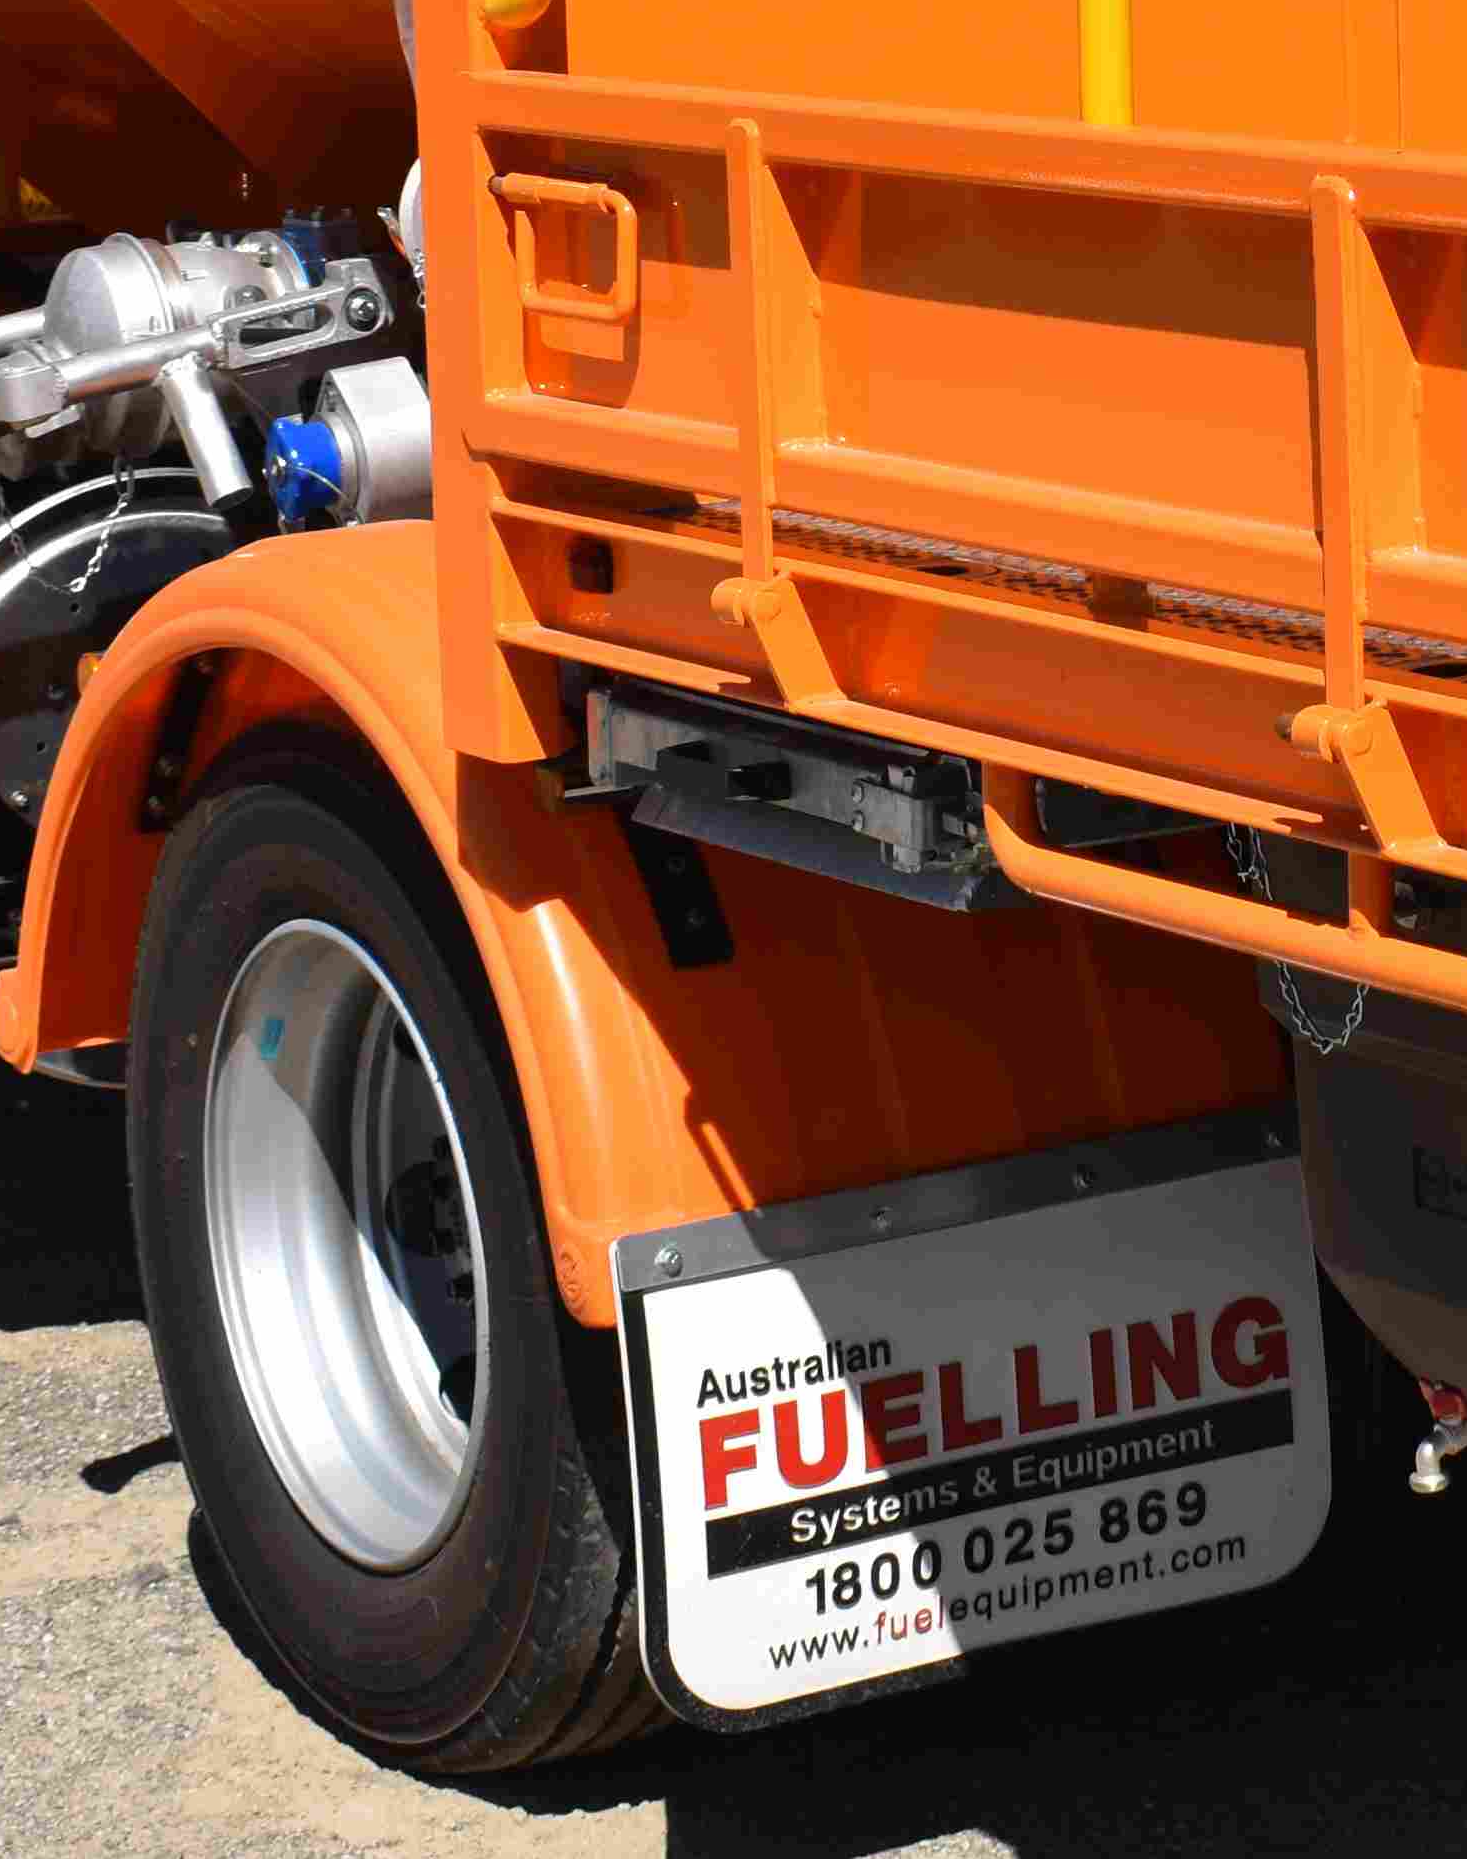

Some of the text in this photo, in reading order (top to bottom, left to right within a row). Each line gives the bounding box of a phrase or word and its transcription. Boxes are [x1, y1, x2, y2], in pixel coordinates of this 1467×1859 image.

[696, 1335, 893, 1409] Australian
[697, 1295, 1291, 1512] FUELLING
[789, 1417, 1217, 1547] Systems & Equipment
[805, 1481, 1210, 1616] 1800 025 869
[768, 1532, 1247, 1671] www.fuelequipment.com
